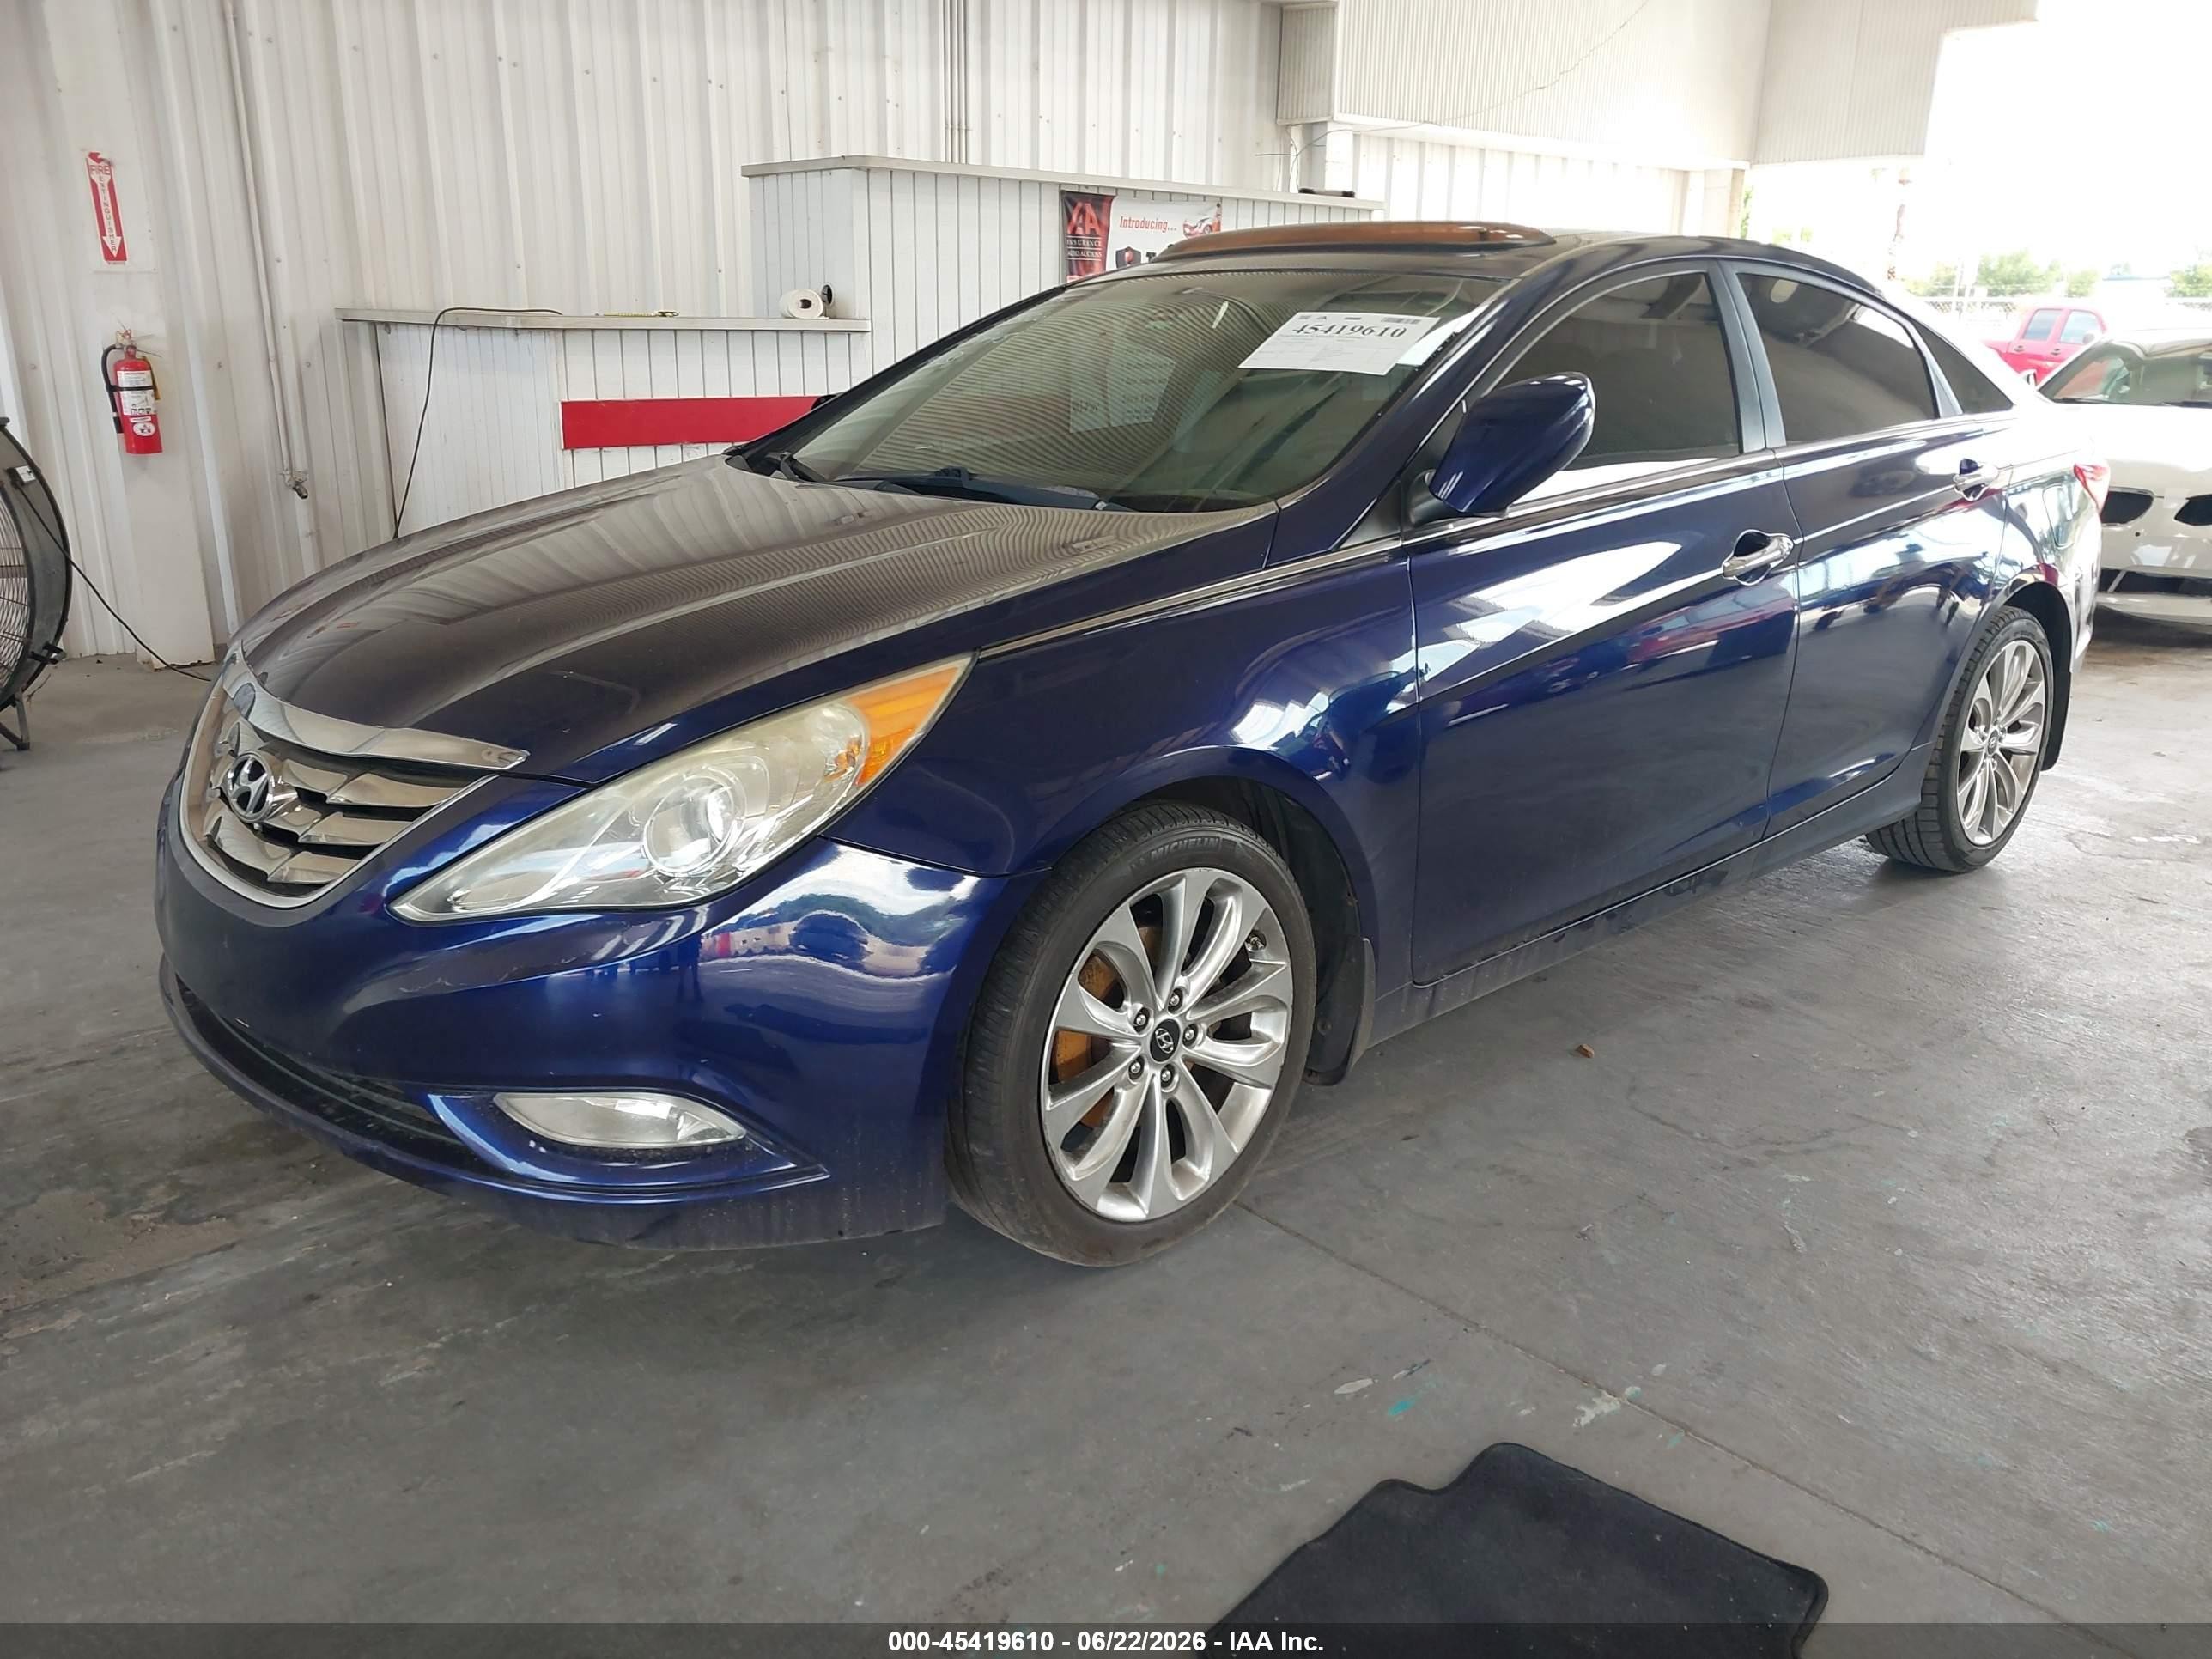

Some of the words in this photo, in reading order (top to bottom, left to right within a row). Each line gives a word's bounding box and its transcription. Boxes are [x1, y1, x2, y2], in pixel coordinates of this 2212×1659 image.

[88, 164, 111, 175] FIRE
[99, 175, 117, 252] EXTINGUISHER
[1119, 216, 1177, 234] Introducing...
[1291, 323, 1407, 338] 45419610
[1150, 836, 1219, 859] MICHELIN
